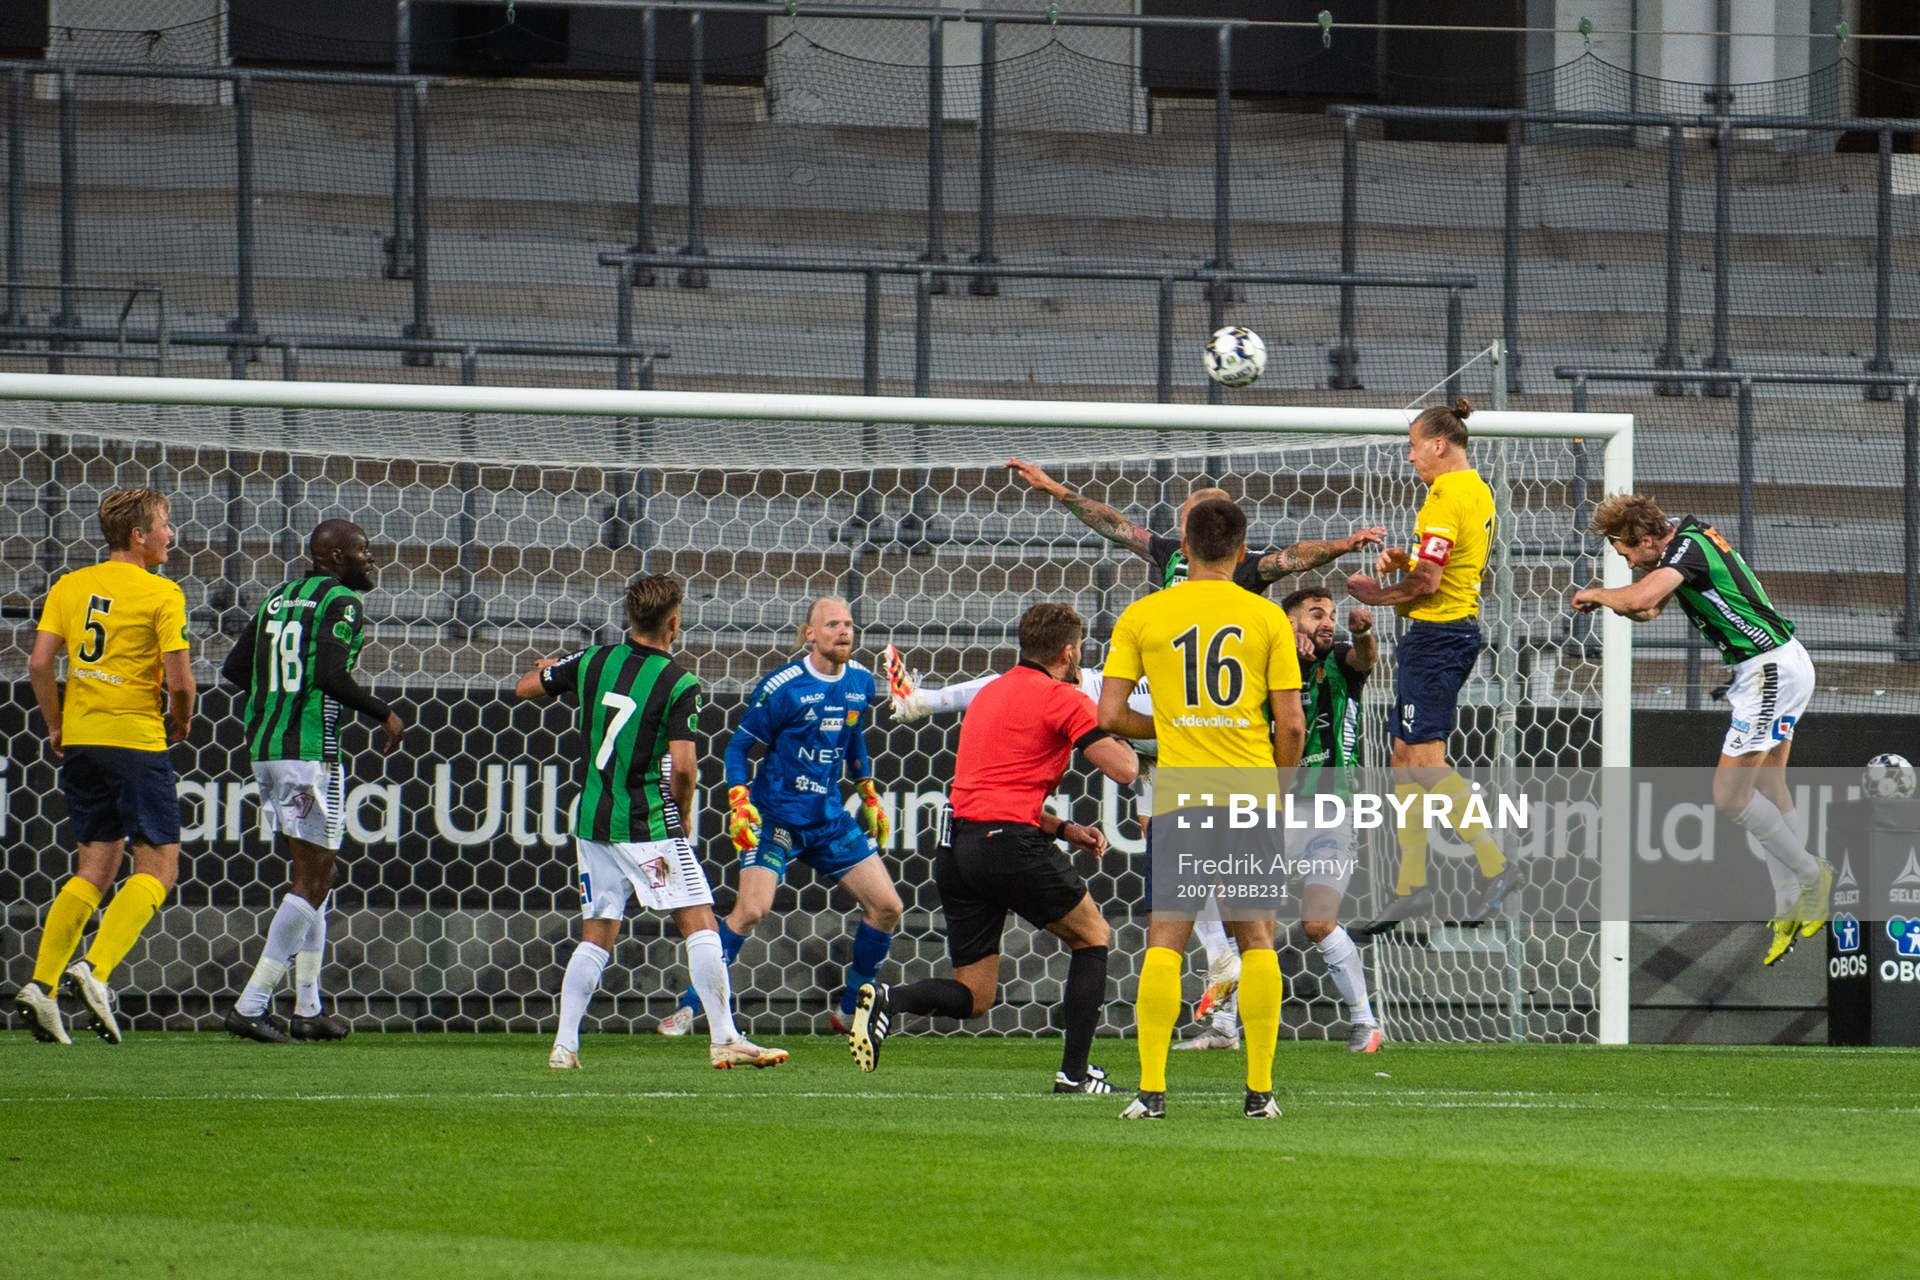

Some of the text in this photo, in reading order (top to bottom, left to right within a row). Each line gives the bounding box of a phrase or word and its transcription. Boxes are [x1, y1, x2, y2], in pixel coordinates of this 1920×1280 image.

[78, 592, 114, 664] 5
[265, 619, 303, 693] 18
[1171, 624, 1245, 708] 16
[595, 691, 637, 771] 7
[1404, 703, 1415, 719] 10
[1834, 890, 1860, 905] SELECT
[1829, 954, 1868, 978] OBOS
